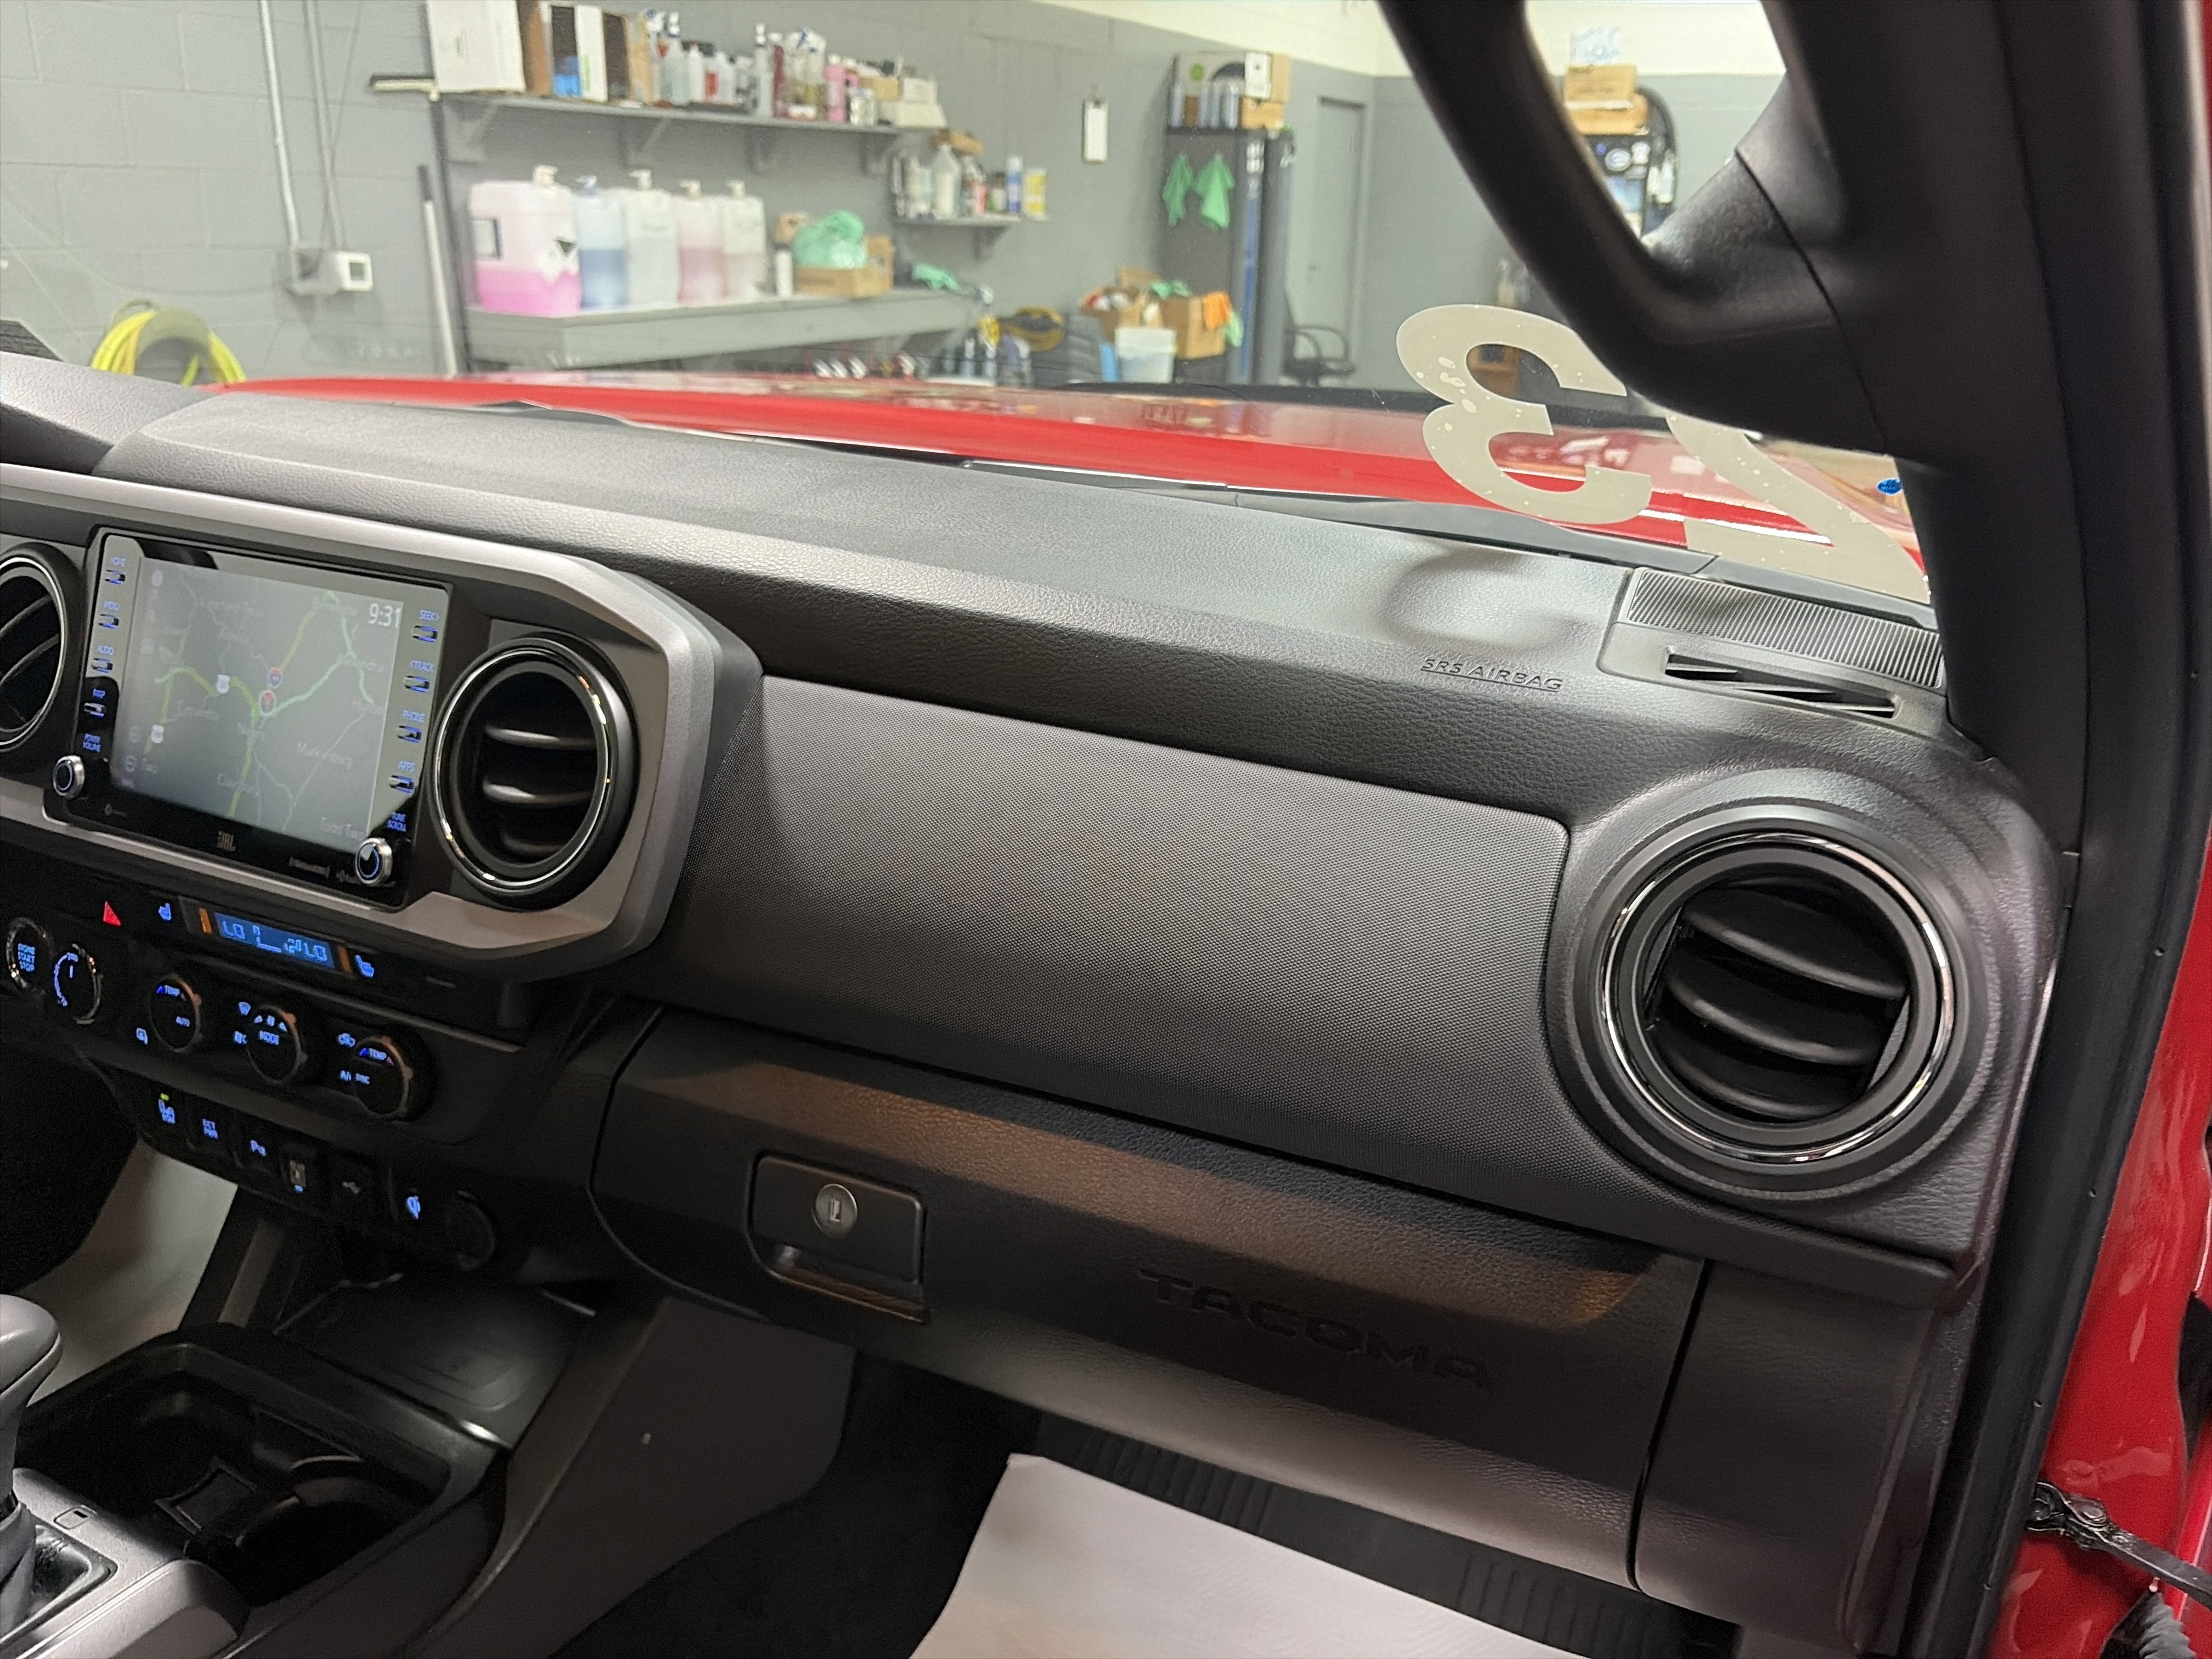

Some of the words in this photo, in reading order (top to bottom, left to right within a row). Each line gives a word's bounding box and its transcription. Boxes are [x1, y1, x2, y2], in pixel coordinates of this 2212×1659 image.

[368, 603, 402, 629] 9:31
[1422, 659, 1463, 673] SRS
[1468, 666, 1563, 690] AIRBAG
[1139, 1267, 1491, 1388] TACOMA
